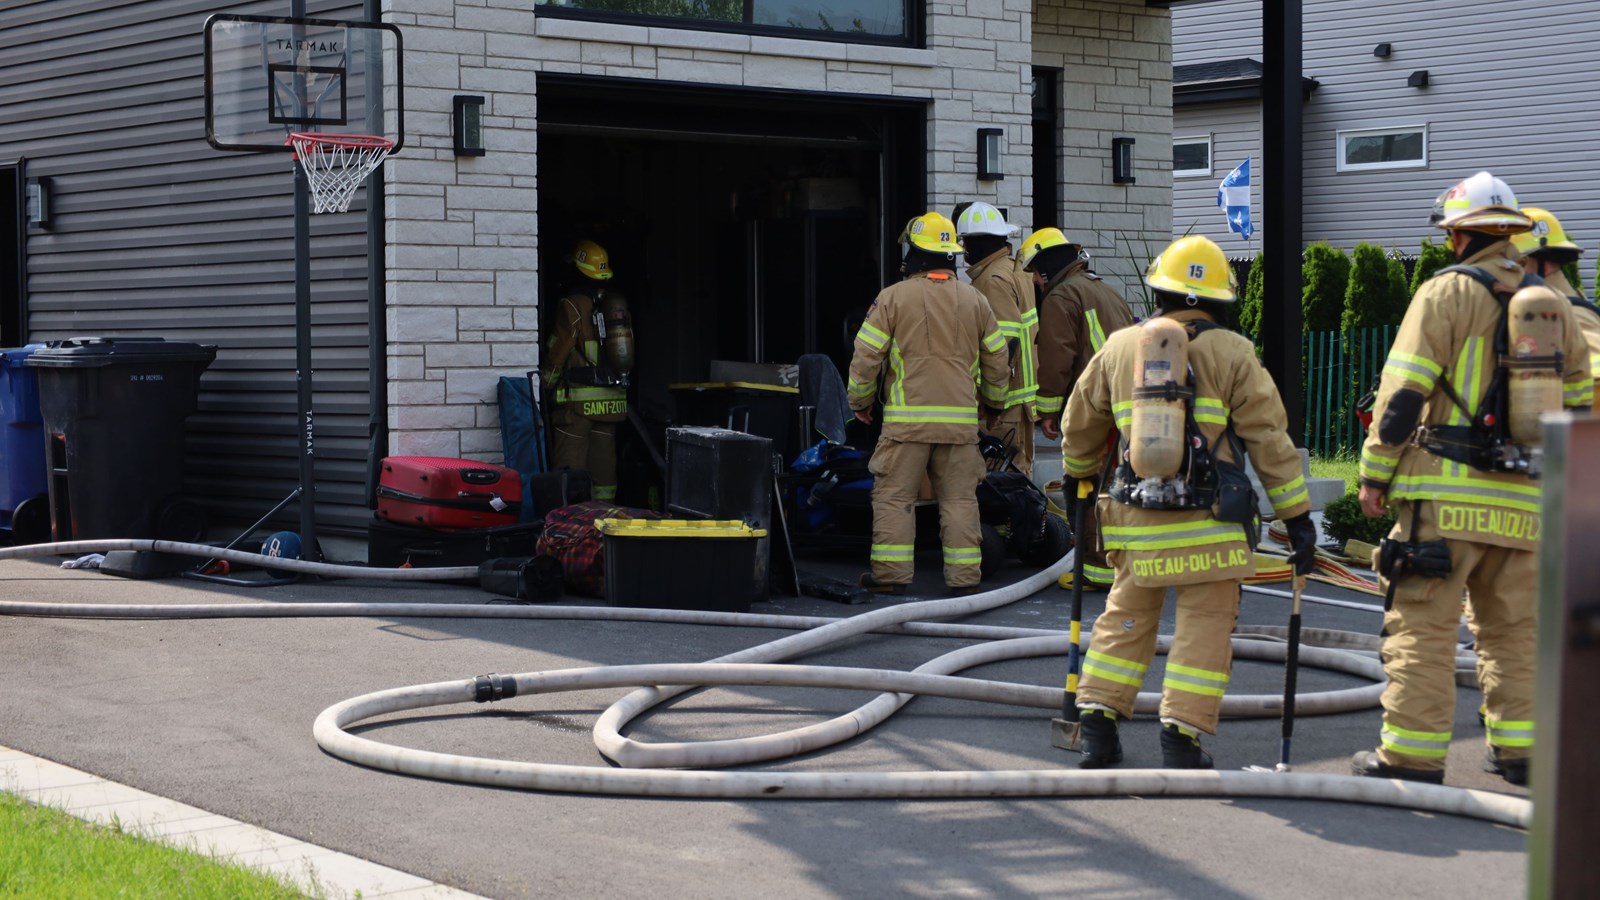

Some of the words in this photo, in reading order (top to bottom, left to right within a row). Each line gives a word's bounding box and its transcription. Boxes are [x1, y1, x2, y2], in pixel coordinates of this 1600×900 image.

[276, 39, 338, 52] TARMAK
[1490, 195, 1503, 206] 15
[940, 232, 950, 242] 23
[1189, 264, 1204, 279] 15
[306, 409, 314, 455] TARMAK
[1132, 549, 1249, 577] COTEAU-DU-LAC
